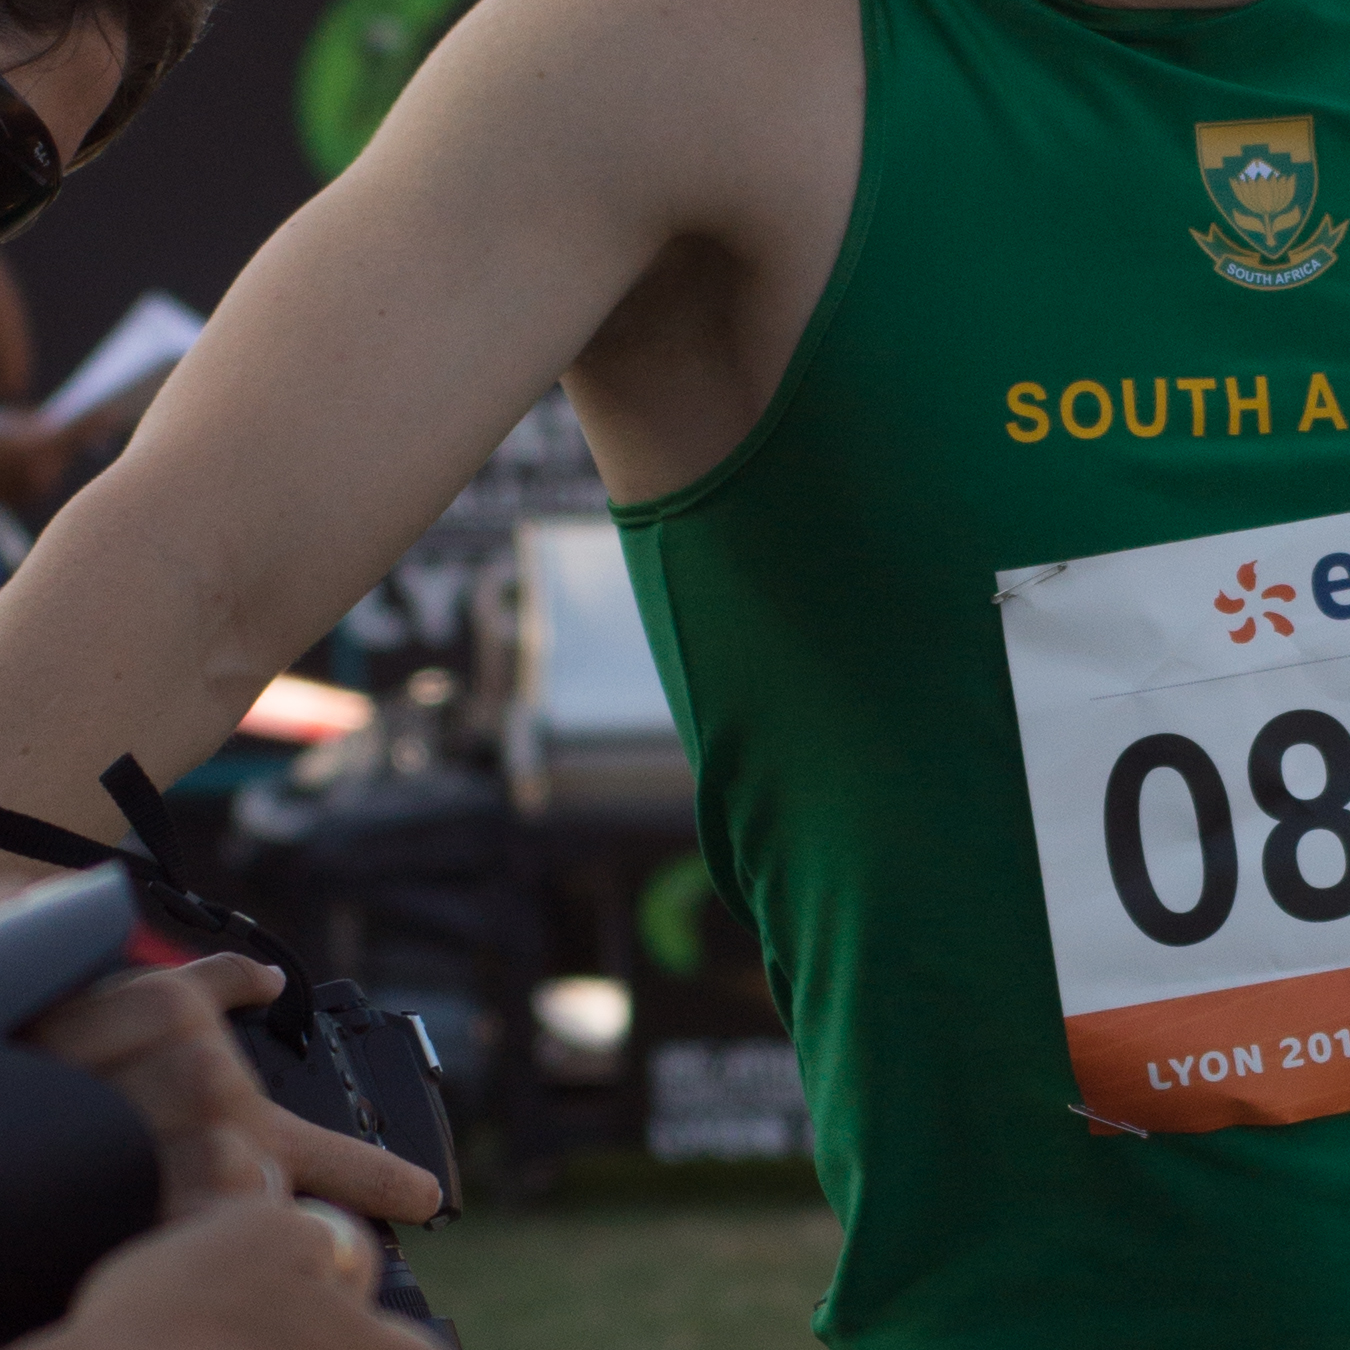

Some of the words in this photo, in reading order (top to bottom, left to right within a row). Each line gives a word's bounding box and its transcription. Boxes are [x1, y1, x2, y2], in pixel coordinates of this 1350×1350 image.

[1226, 262, 1272, 285] SOUTH
[1275, 258, 1322, 285] AFRICA
[1004, 374, 1272, 444] SOUTH
[1146, 1042, 1264, 1091] LYON
